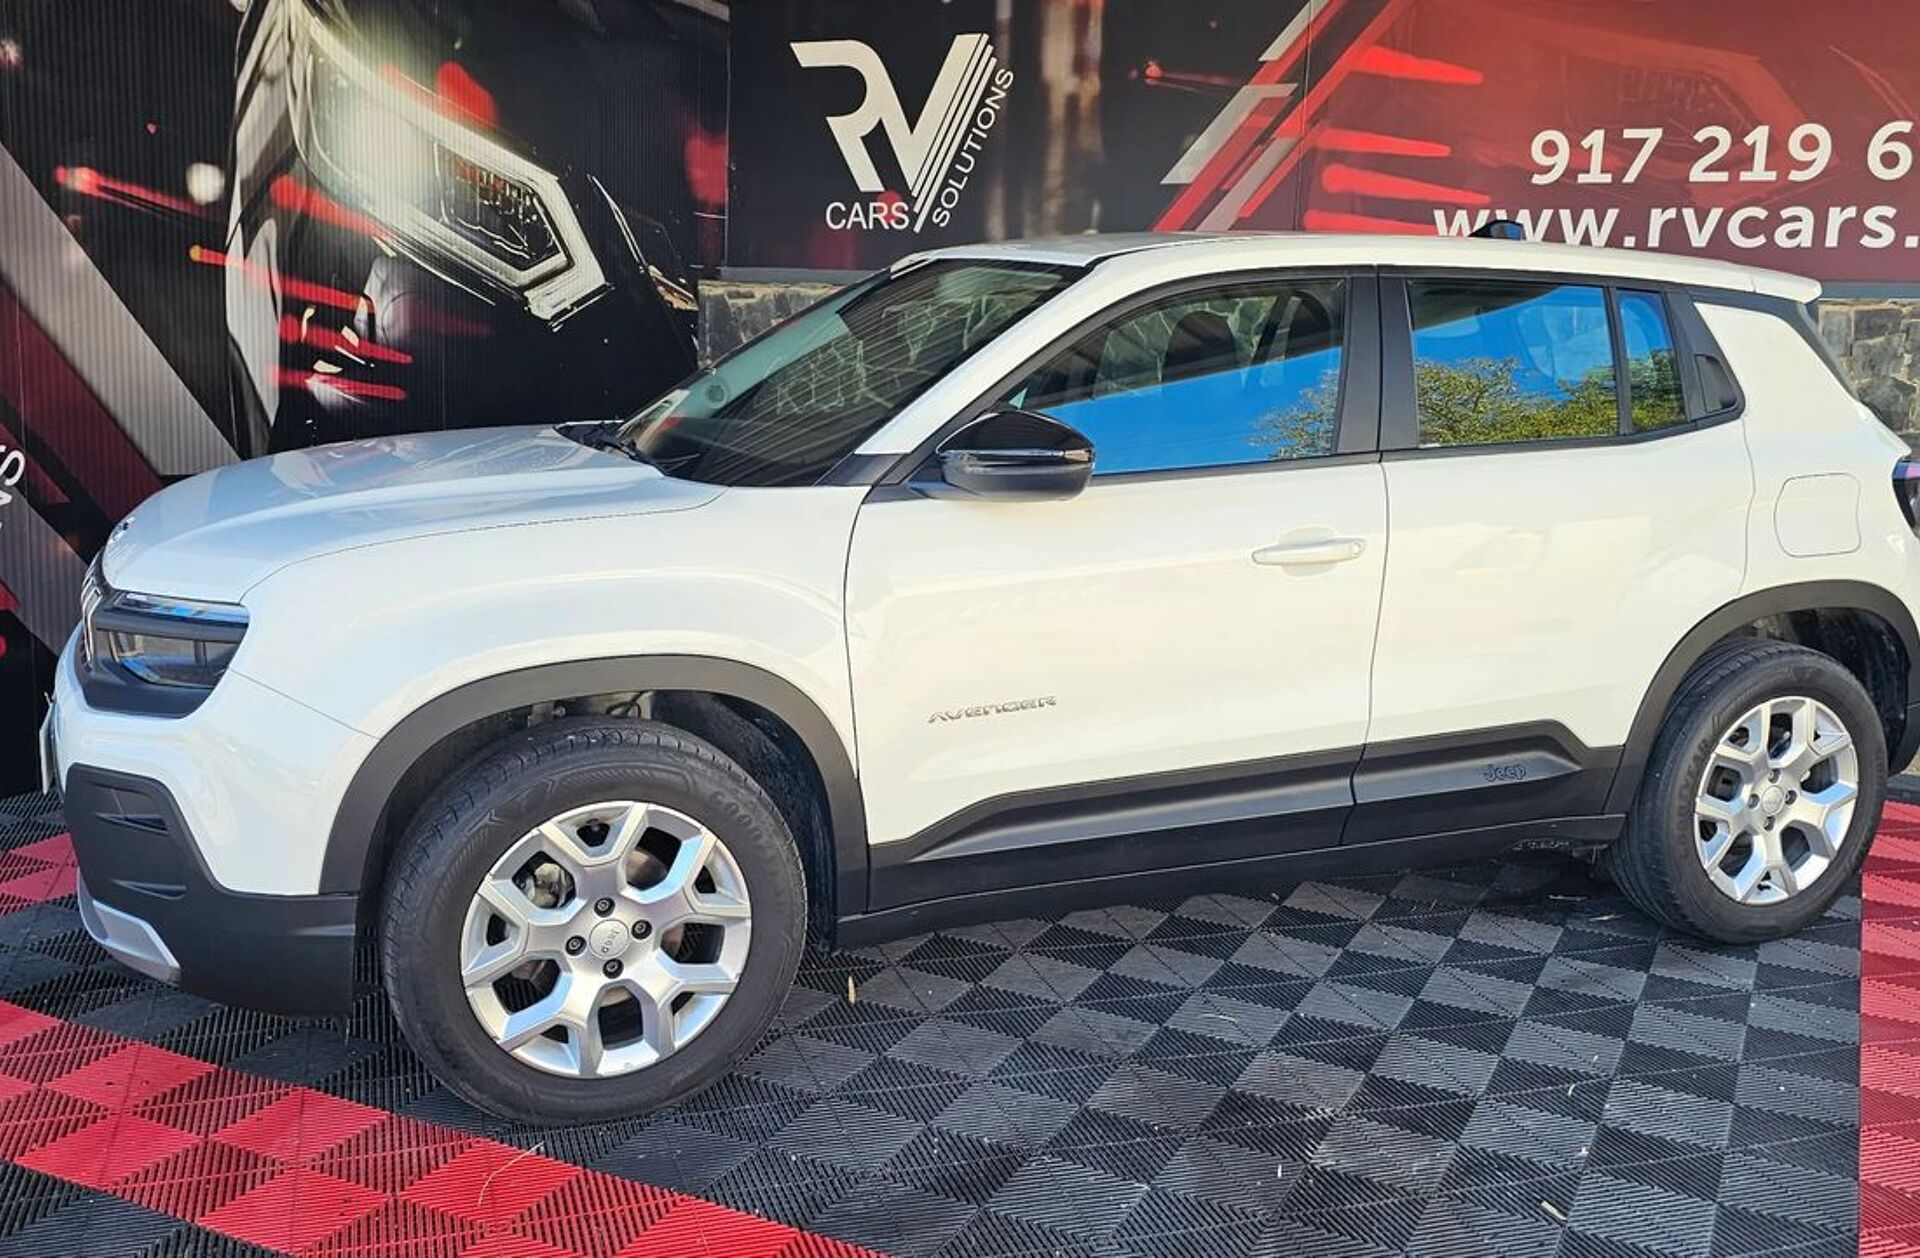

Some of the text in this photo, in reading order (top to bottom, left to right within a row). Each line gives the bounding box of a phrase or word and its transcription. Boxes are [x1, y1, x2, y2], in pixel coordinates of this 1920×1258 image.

[790, 32, 994, 210] RV
[931, 68, 1015, 228] SOLUTIONS
[1530, 120, 1914, 185] 917 219 6
[825, 201, 910, 230] CARS
